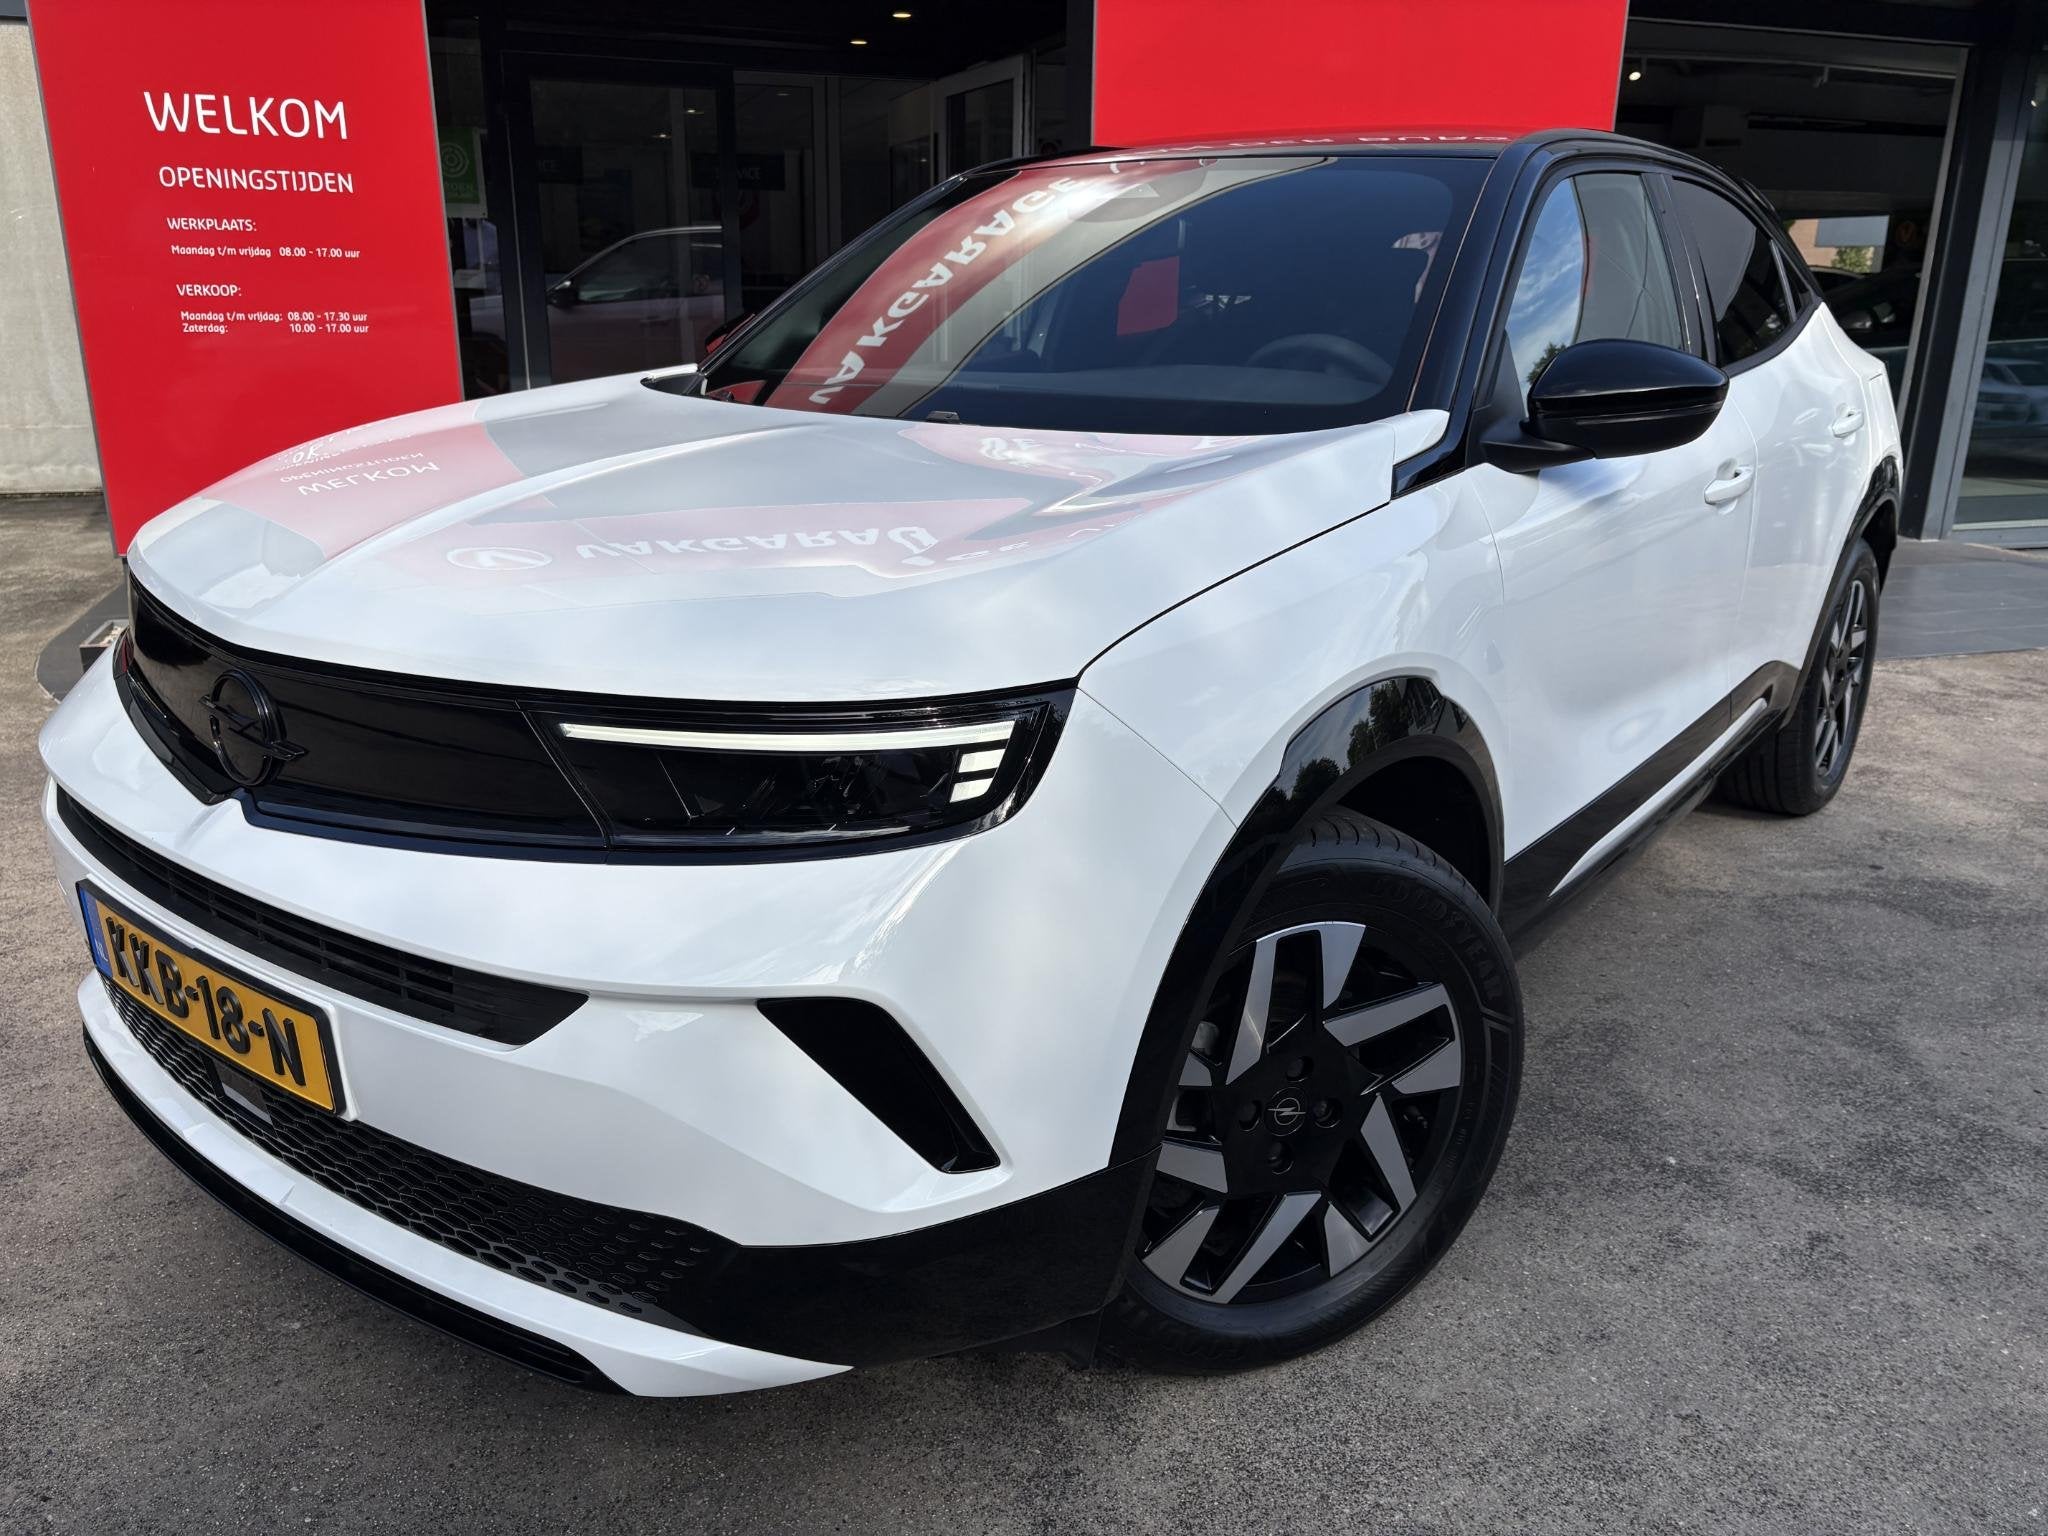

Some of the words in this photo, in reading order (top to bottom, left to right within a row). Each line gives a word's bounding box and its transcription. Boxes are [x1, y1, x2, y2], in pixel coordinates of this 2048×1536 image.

[143, 91, 348, 140] WELKOM
[158, 166, 354, 193] OPENINGSTIJDEN
[167, 217, 257, 232] WERKPLAATS:
[171, 245, 215, 257] Maandag
[217, 245, 237, 256] t/m
[239, 246, 272, 258] vrijdag
[279, 247, 307, 257] 08.00
[316, 247, 342, 258] 17.00
[345, 250, 361, 258] uur
[176, 284, 242, 297] VERKOOP:
[180, 311, 224, 323] Maandag
[226, 311, 245, 321] t/m
[248, 312, 283, 323] vrijdag:
[287, 312, 314, 321] 08.00
[324, 312, 350, 321] 17.30
[352, 313, 368, 321] uur
[183, 324, 229, 334] Zaterdag:
[289, 324, 316, 333] 10.00
[325, 324, 351, 333] 17.00
[353, 325, 369, 333] uur
[106, 917, 306, 1087] KKB-18-N
